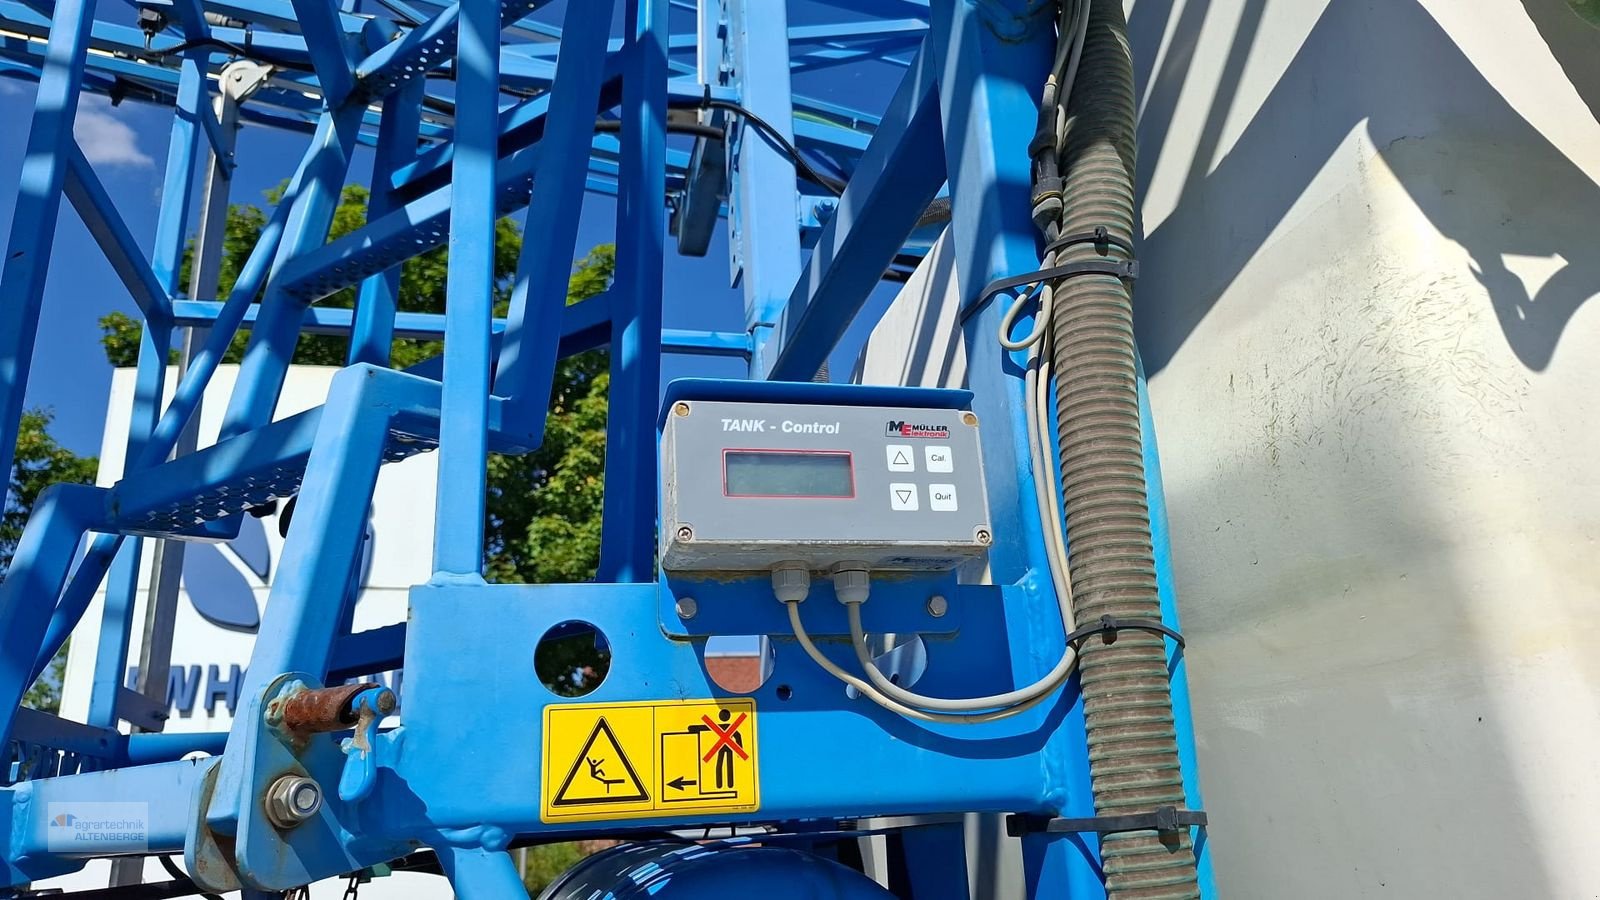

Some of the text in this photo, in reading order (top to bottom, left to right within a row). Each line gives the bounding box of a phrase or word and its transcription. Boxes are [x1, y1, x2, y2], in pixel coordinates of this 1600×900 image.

[721, 419, 766, 433] TANK
[781, 420, 841, 434] Control
[912, 423, 949, 432] MÜLLER
[935, 492, 952, 501] Quit
